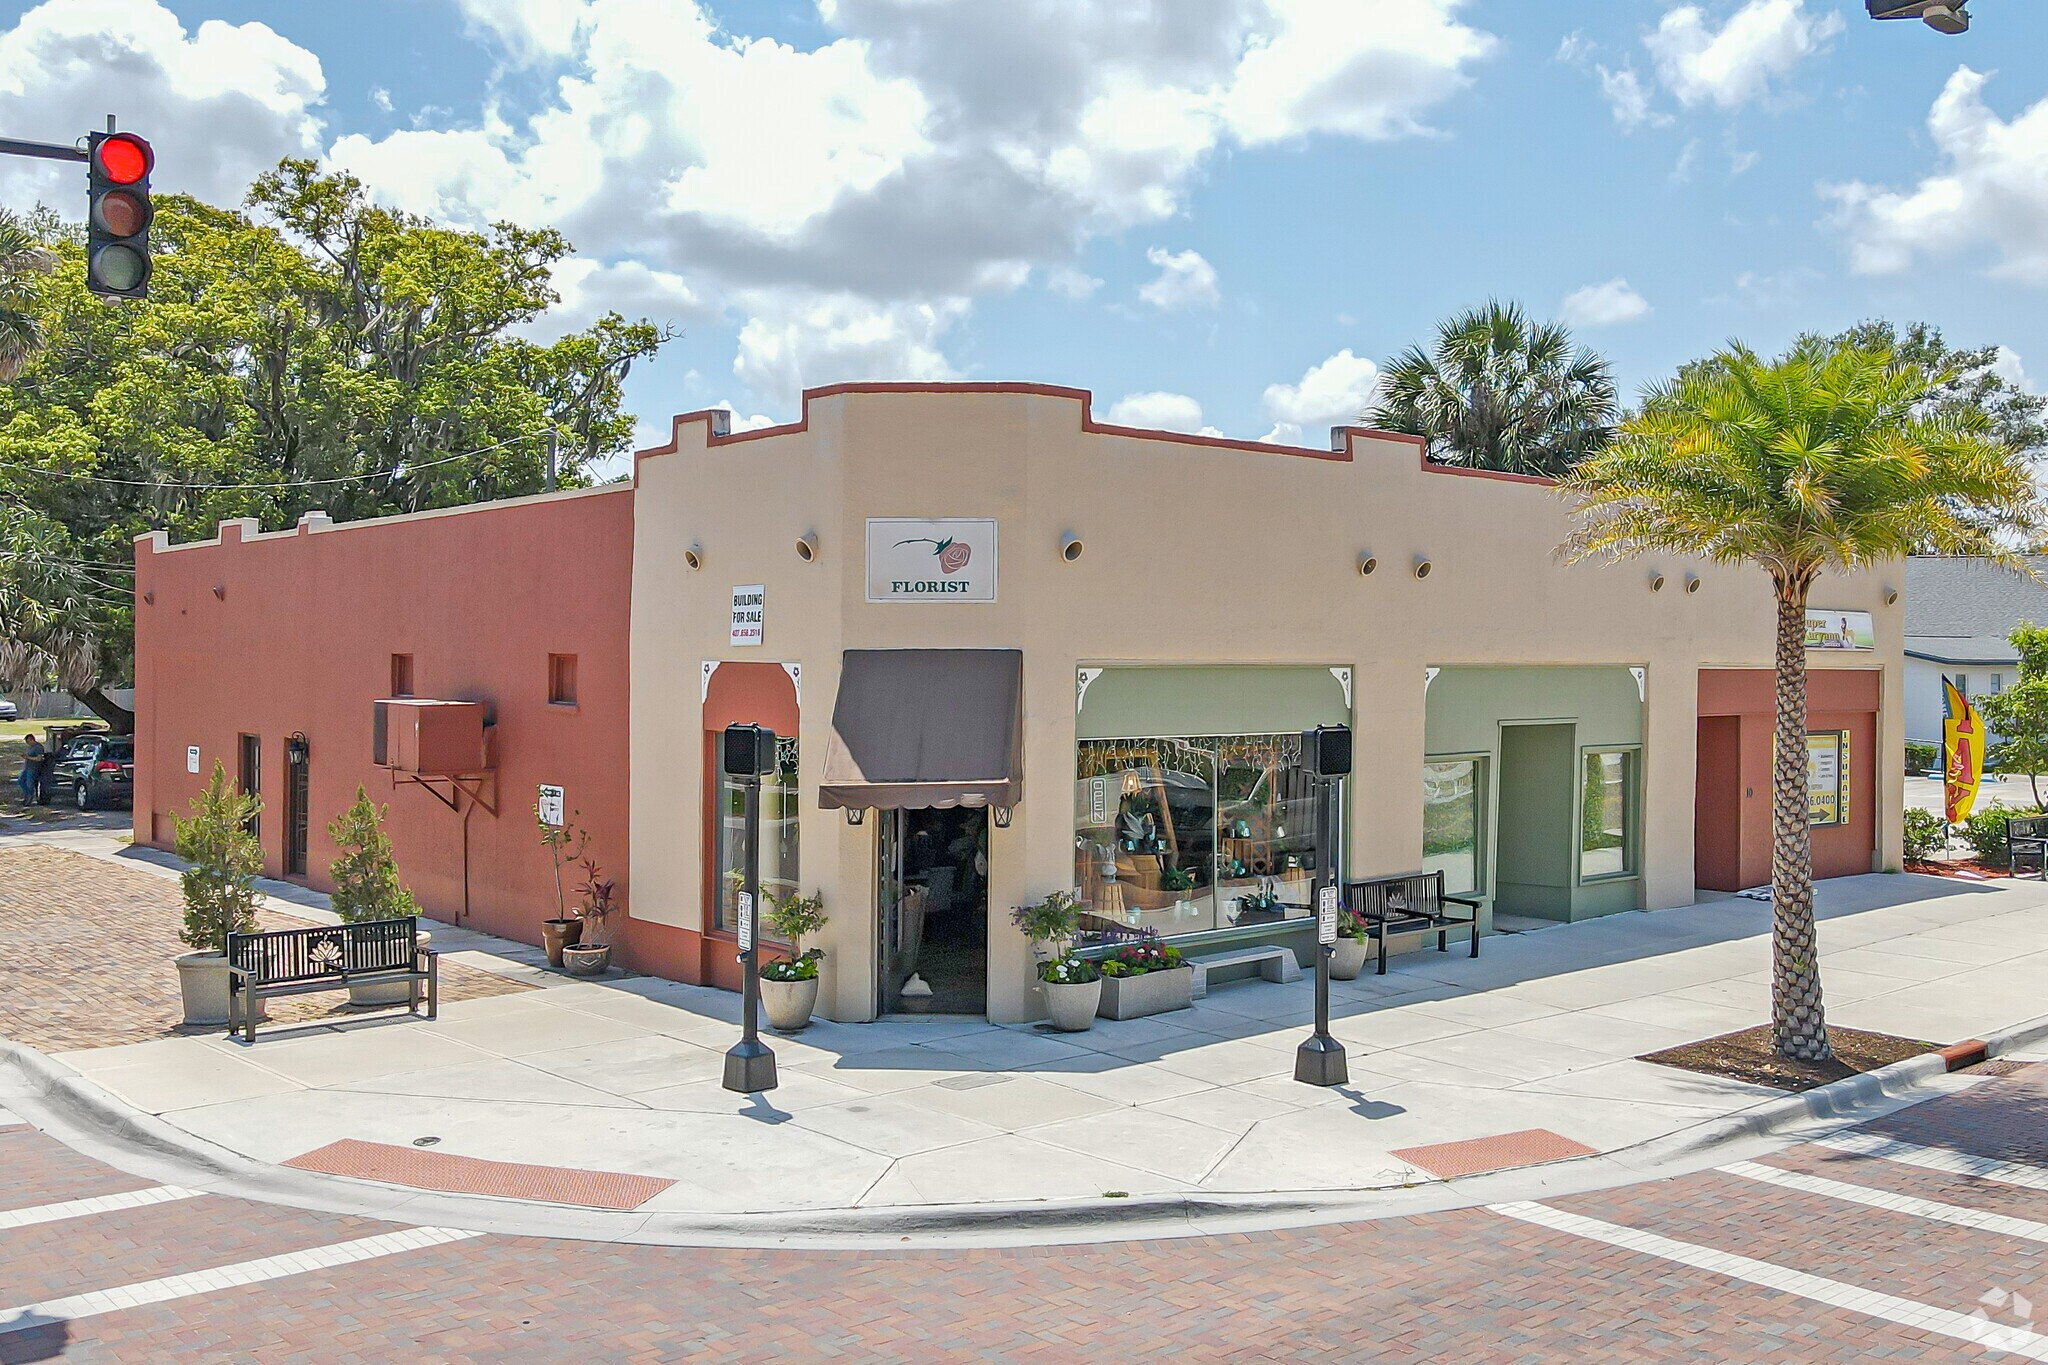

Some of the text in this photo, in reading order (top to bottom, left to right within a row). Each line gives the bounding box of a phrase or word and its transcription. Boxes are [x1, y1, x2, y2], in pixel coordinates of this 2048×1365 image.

[891, 581, 970, 593] FLORIST
[733, 594, 762, 606] BUILDING
[732, 611, 762, 623] FOR SALE
[1805, 619, 1826, 631] uper
[1093, 781, 1104, 821] OPEN
